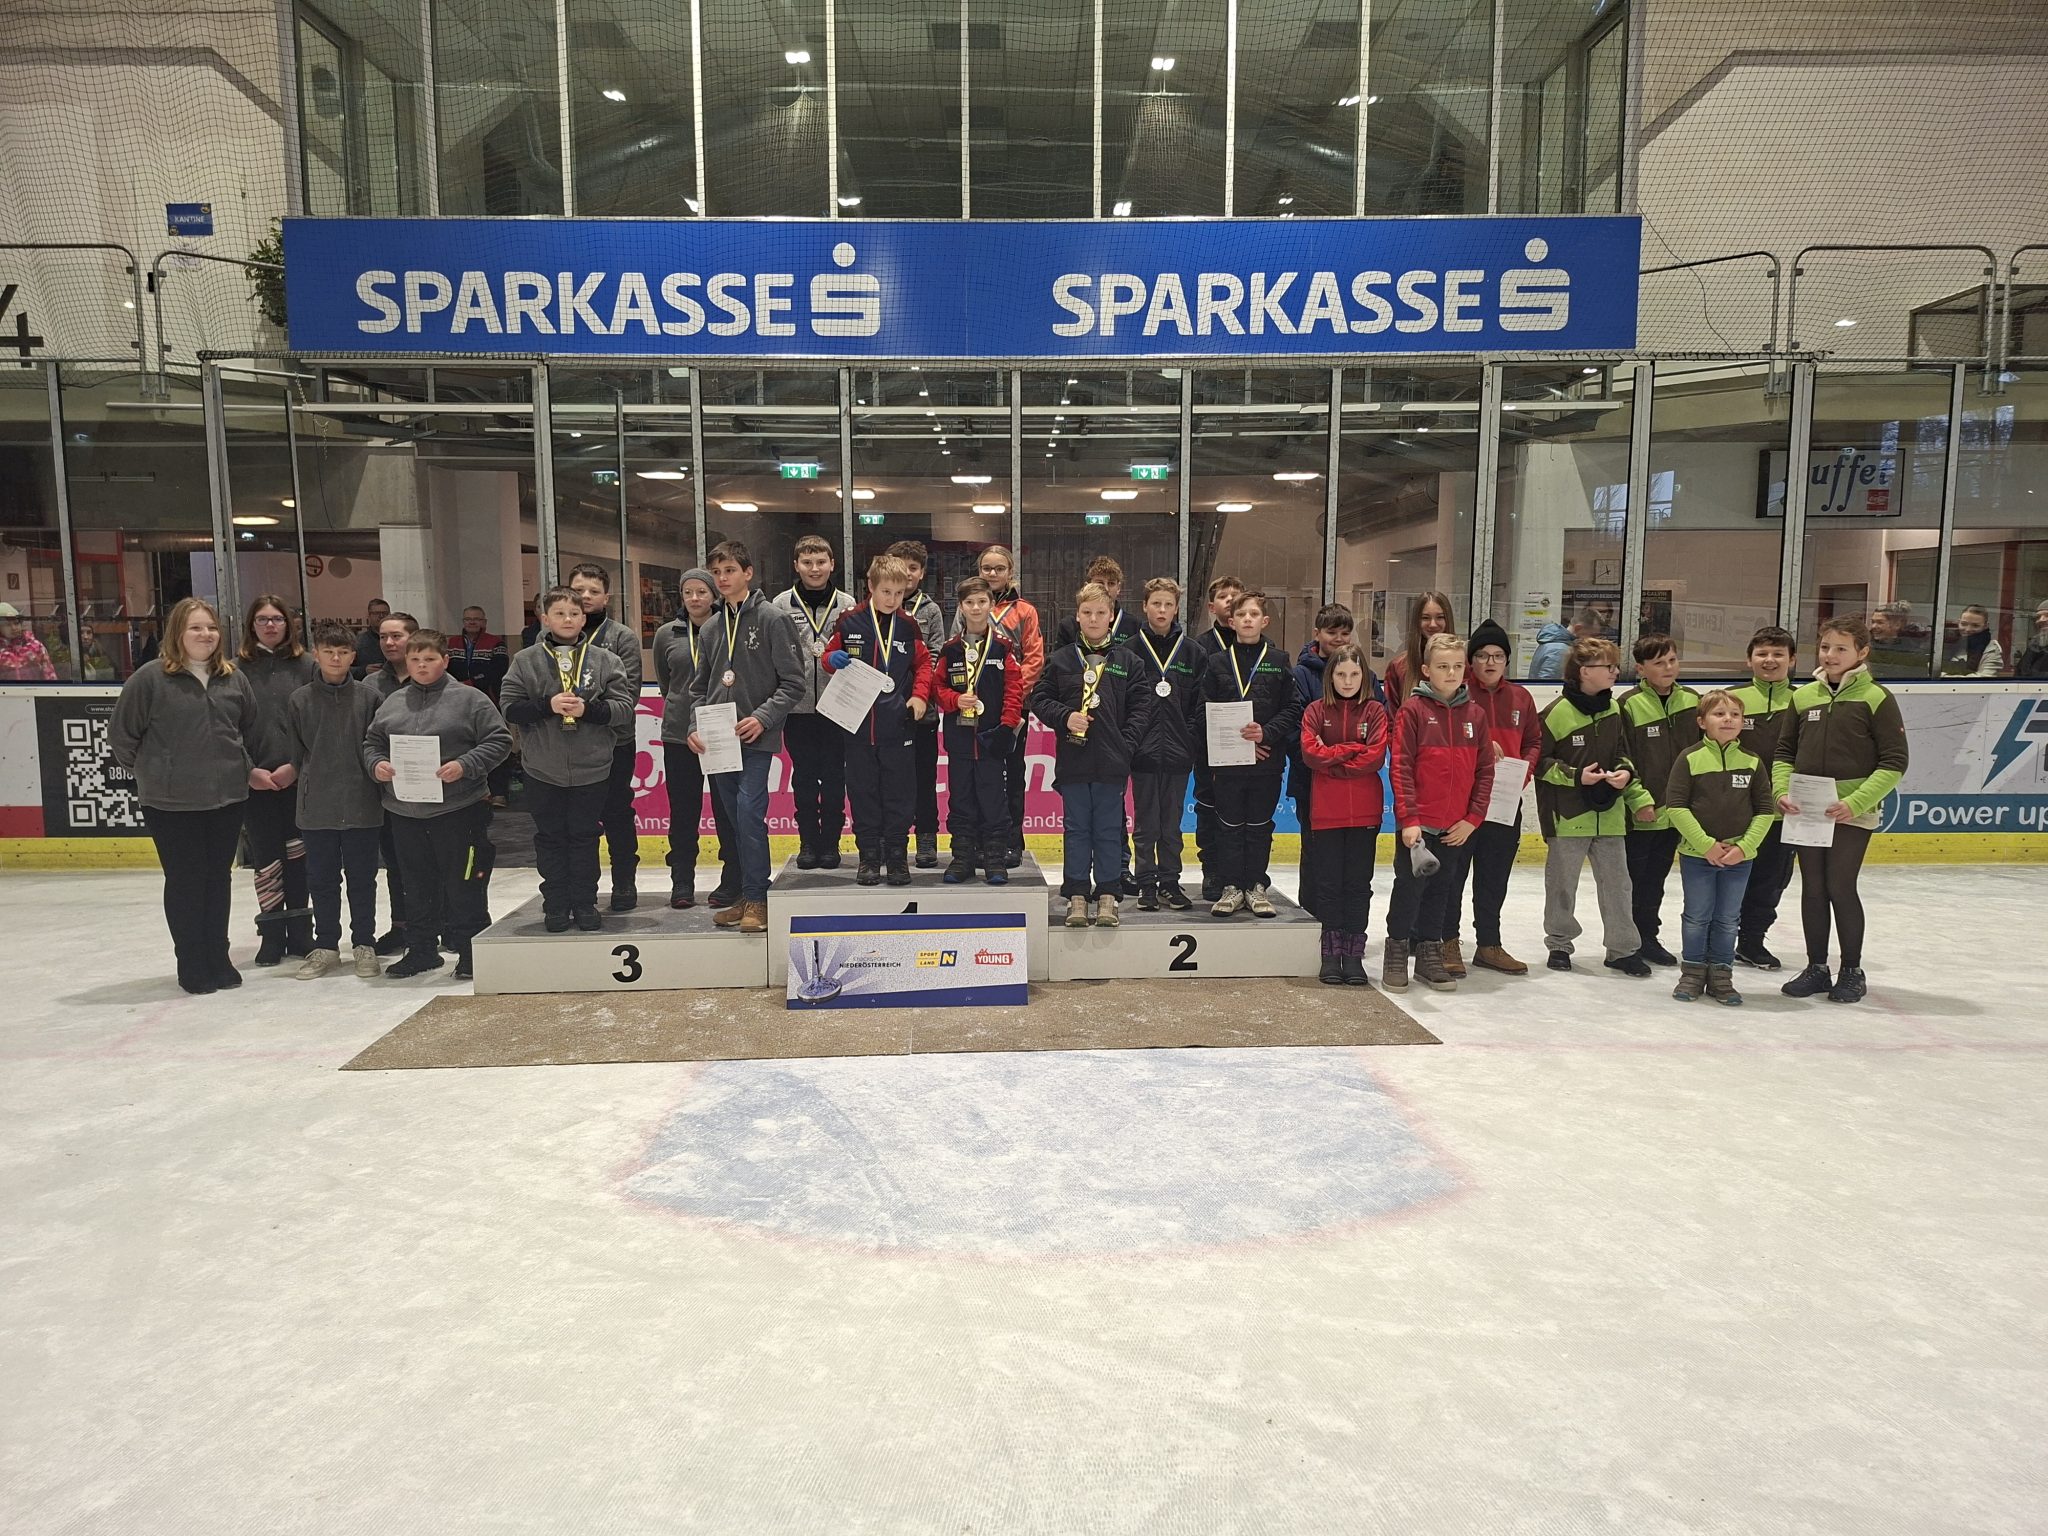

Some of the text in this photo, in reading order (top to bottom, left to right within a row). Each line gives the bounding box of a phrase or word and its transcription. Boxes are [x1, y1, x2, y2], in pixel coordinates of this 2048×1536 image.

[174, 215, 205, 223] KANTINE
[356, 270, 796, 336] SPARKASSE
[1052, 269, 1484, 336] SPARKASSE
[1811, 454, 1889, 512] uffet
[1732, 775, 1751, 784] ESV
[1908, 800, 2010, 825] Power
[611, 944, 643, 983] 3
[839, 961, 901, 969] NIEDERÖSTERREICH
[977, 954, 1010, 964] YOUNG
[1169, 934, 1198, 971] 2
